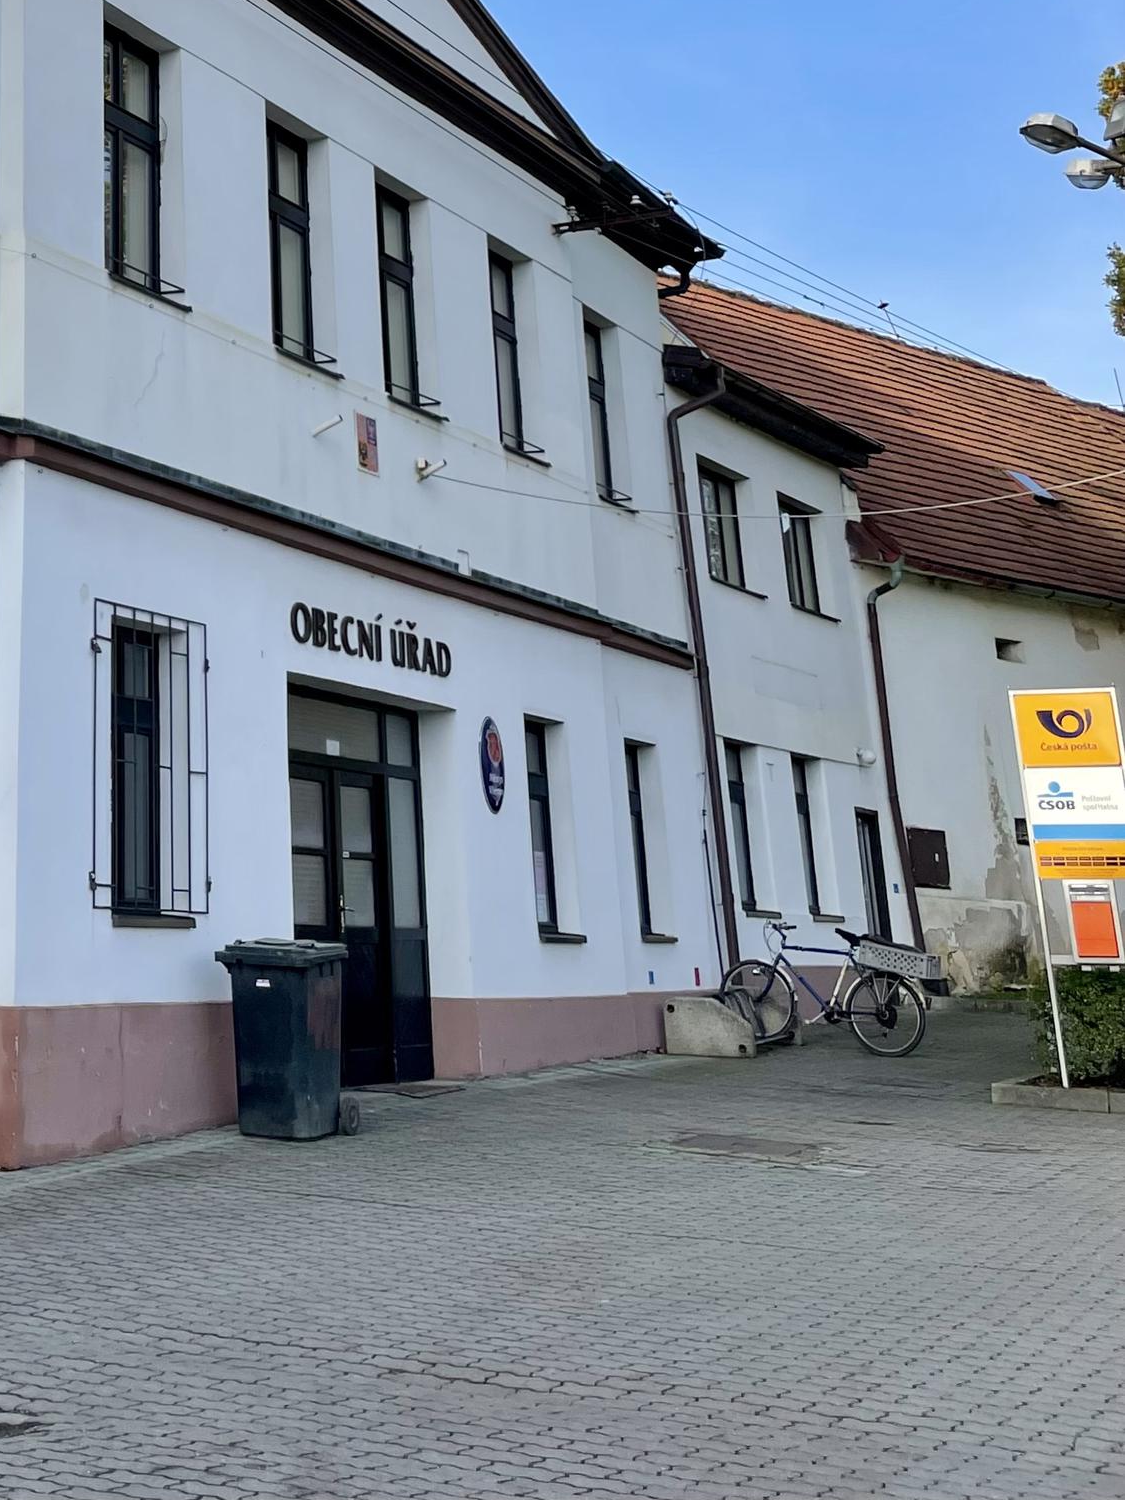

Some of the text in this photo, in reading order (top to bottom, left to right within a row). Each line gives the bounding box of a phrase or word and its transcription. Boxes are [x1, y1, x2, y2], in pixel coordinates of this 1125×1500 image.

[290, 602, 452, 678] OBECNÍ ÚŘAD
[1040, 742, 1097, 751] Česká pošta
